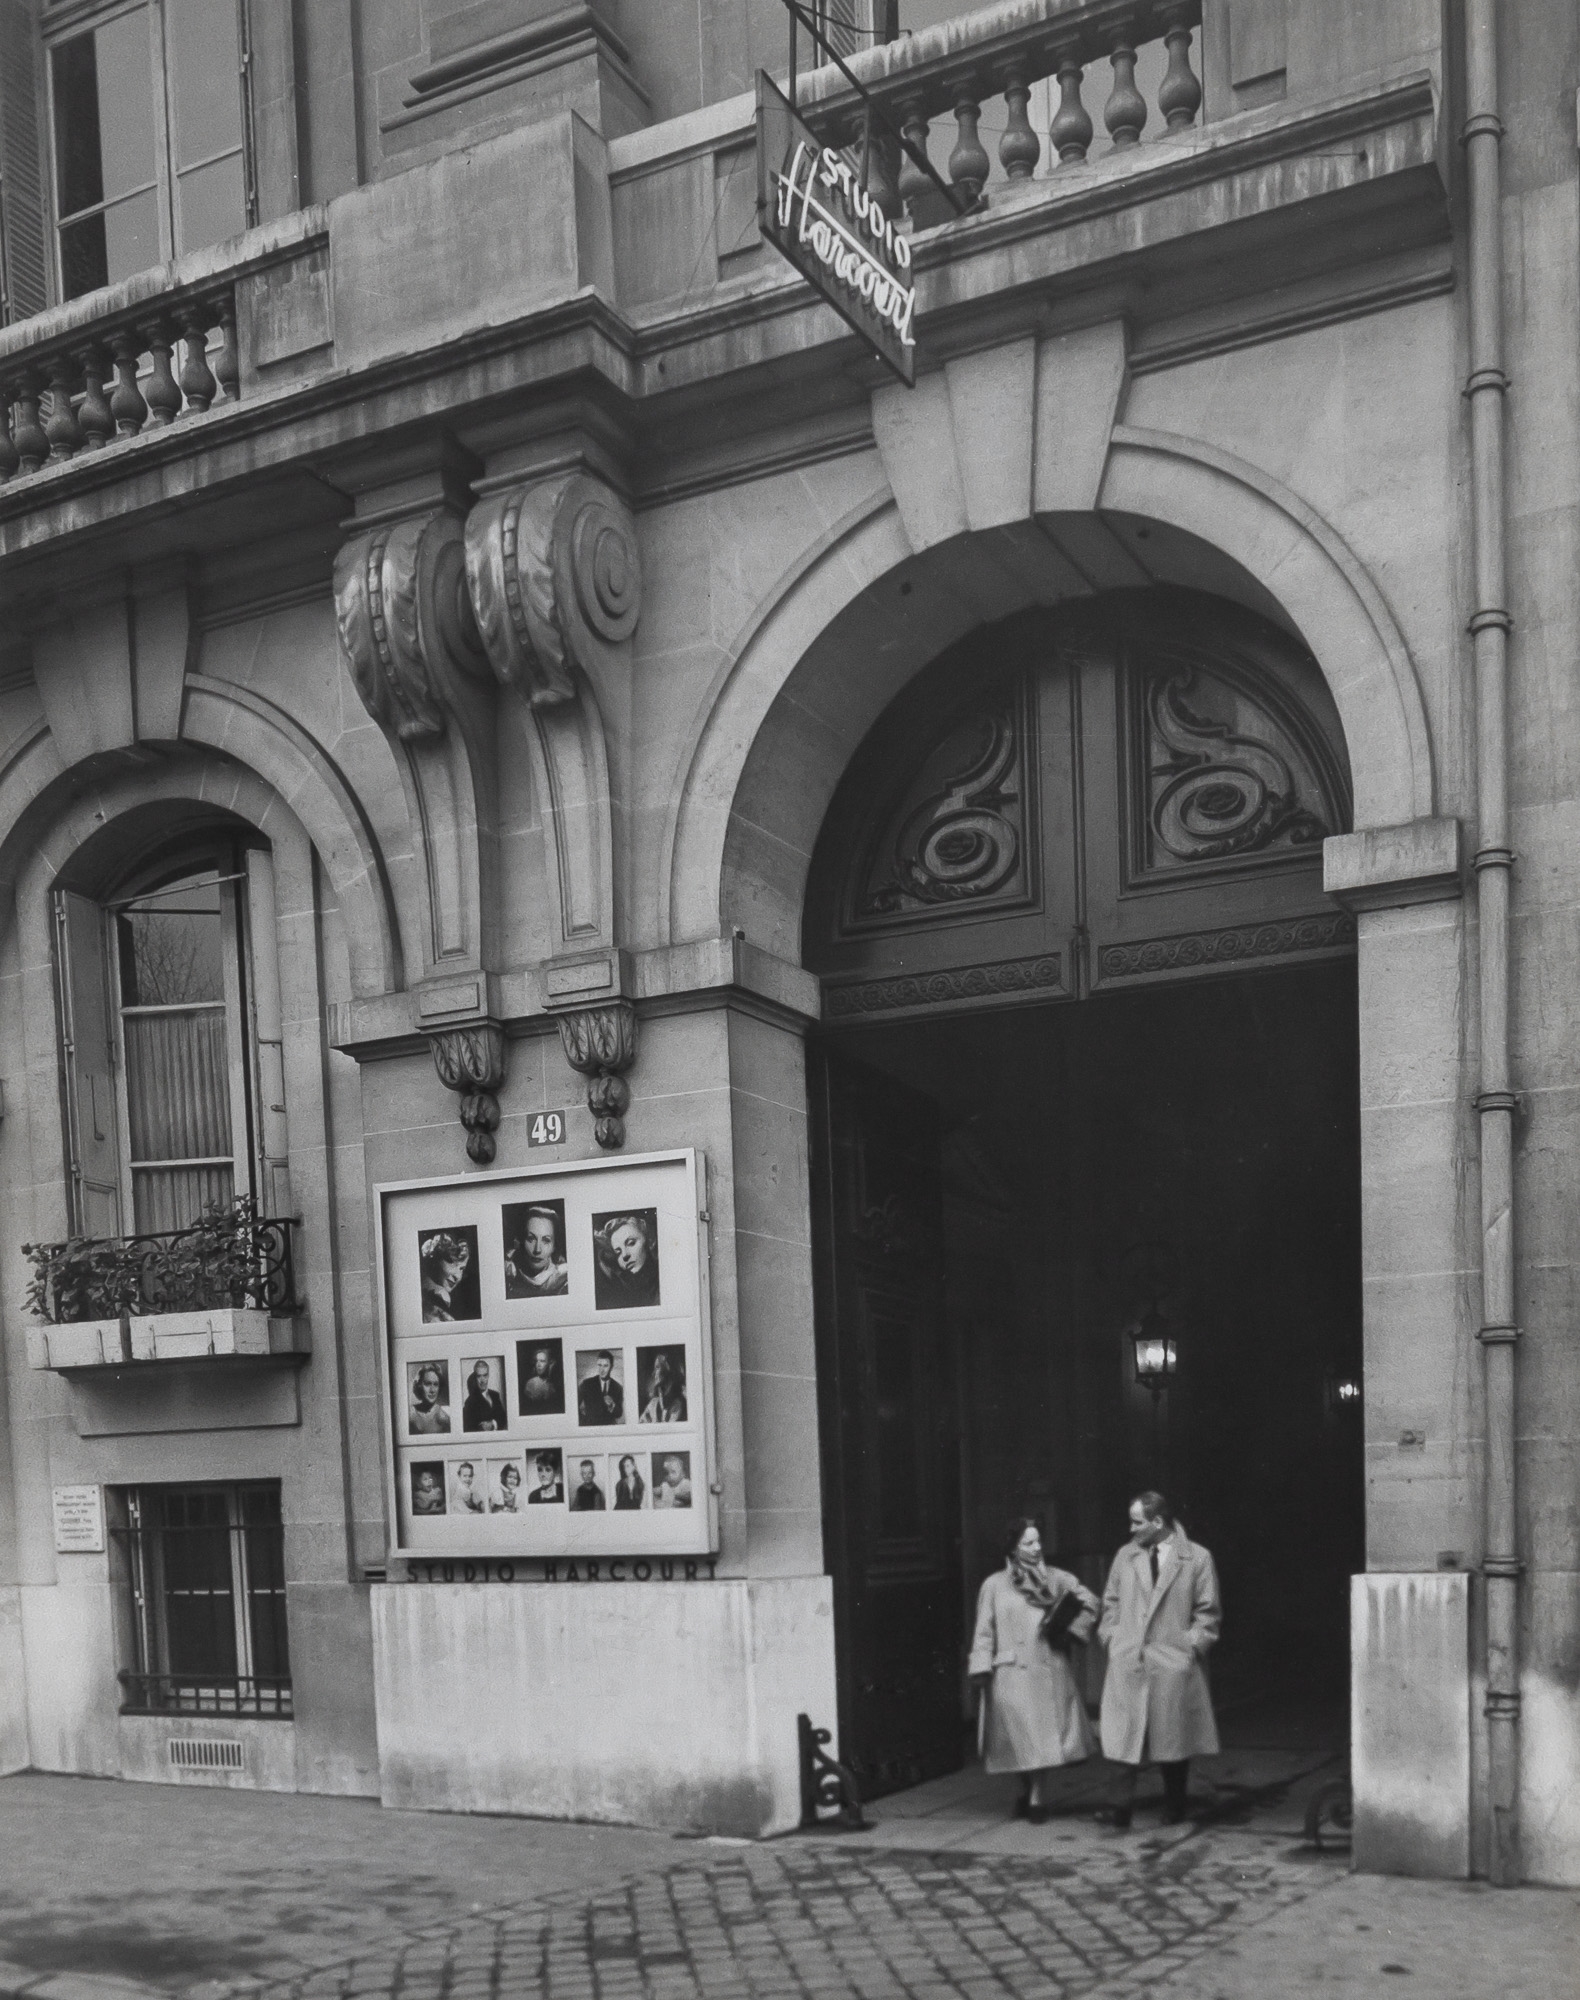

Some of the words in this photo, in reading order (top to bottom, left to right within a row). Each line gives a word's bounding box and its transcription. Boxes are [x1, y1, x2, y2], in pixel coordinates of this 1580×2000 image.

[820, 147, 911, 268] STUDIO
[531, 1113, 562, 1144] 49
[406, 1562, 516, 1583] STUDIO
[544, 1559, 718, 1583] HARCOURT
